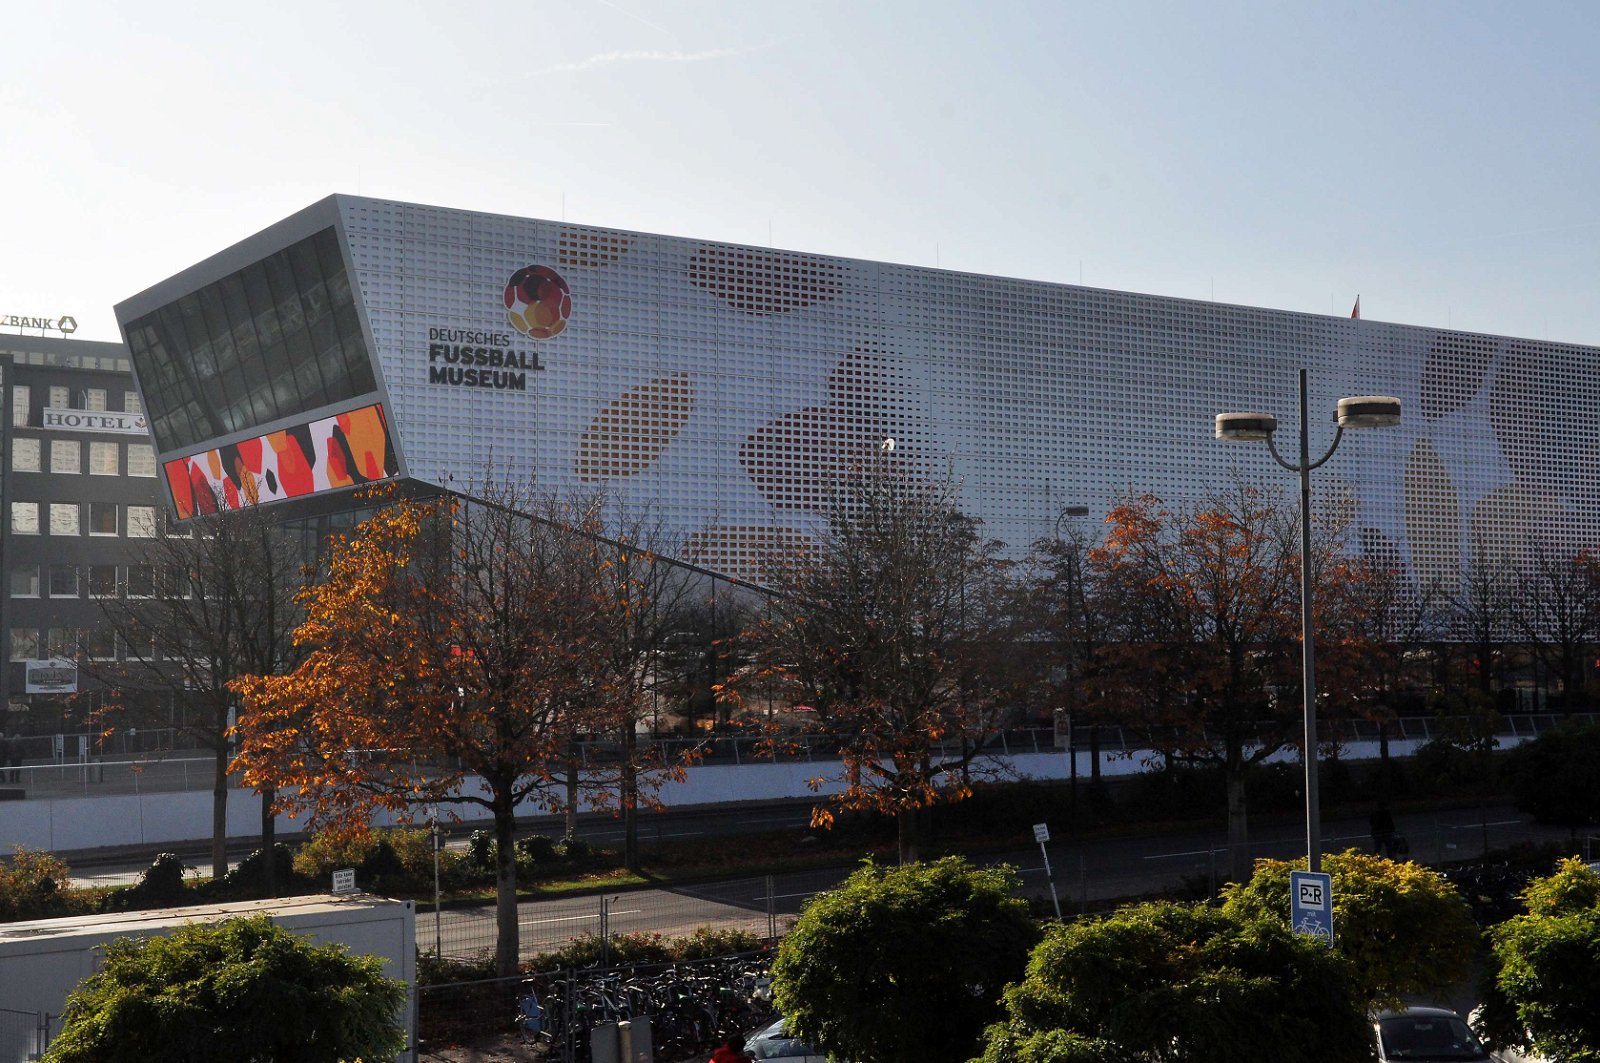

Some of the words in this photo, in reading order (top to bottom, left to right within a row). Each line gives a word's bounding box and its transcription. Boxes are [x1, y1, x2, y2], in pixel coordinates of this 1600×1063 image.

[429, 327, 510, 347] DEUTSCHES
[429, 344, 545, 370] FUSSBALL
[429, 365, 526, 390] MUSEUM
[46, 413, 131, 429] HOTEL
